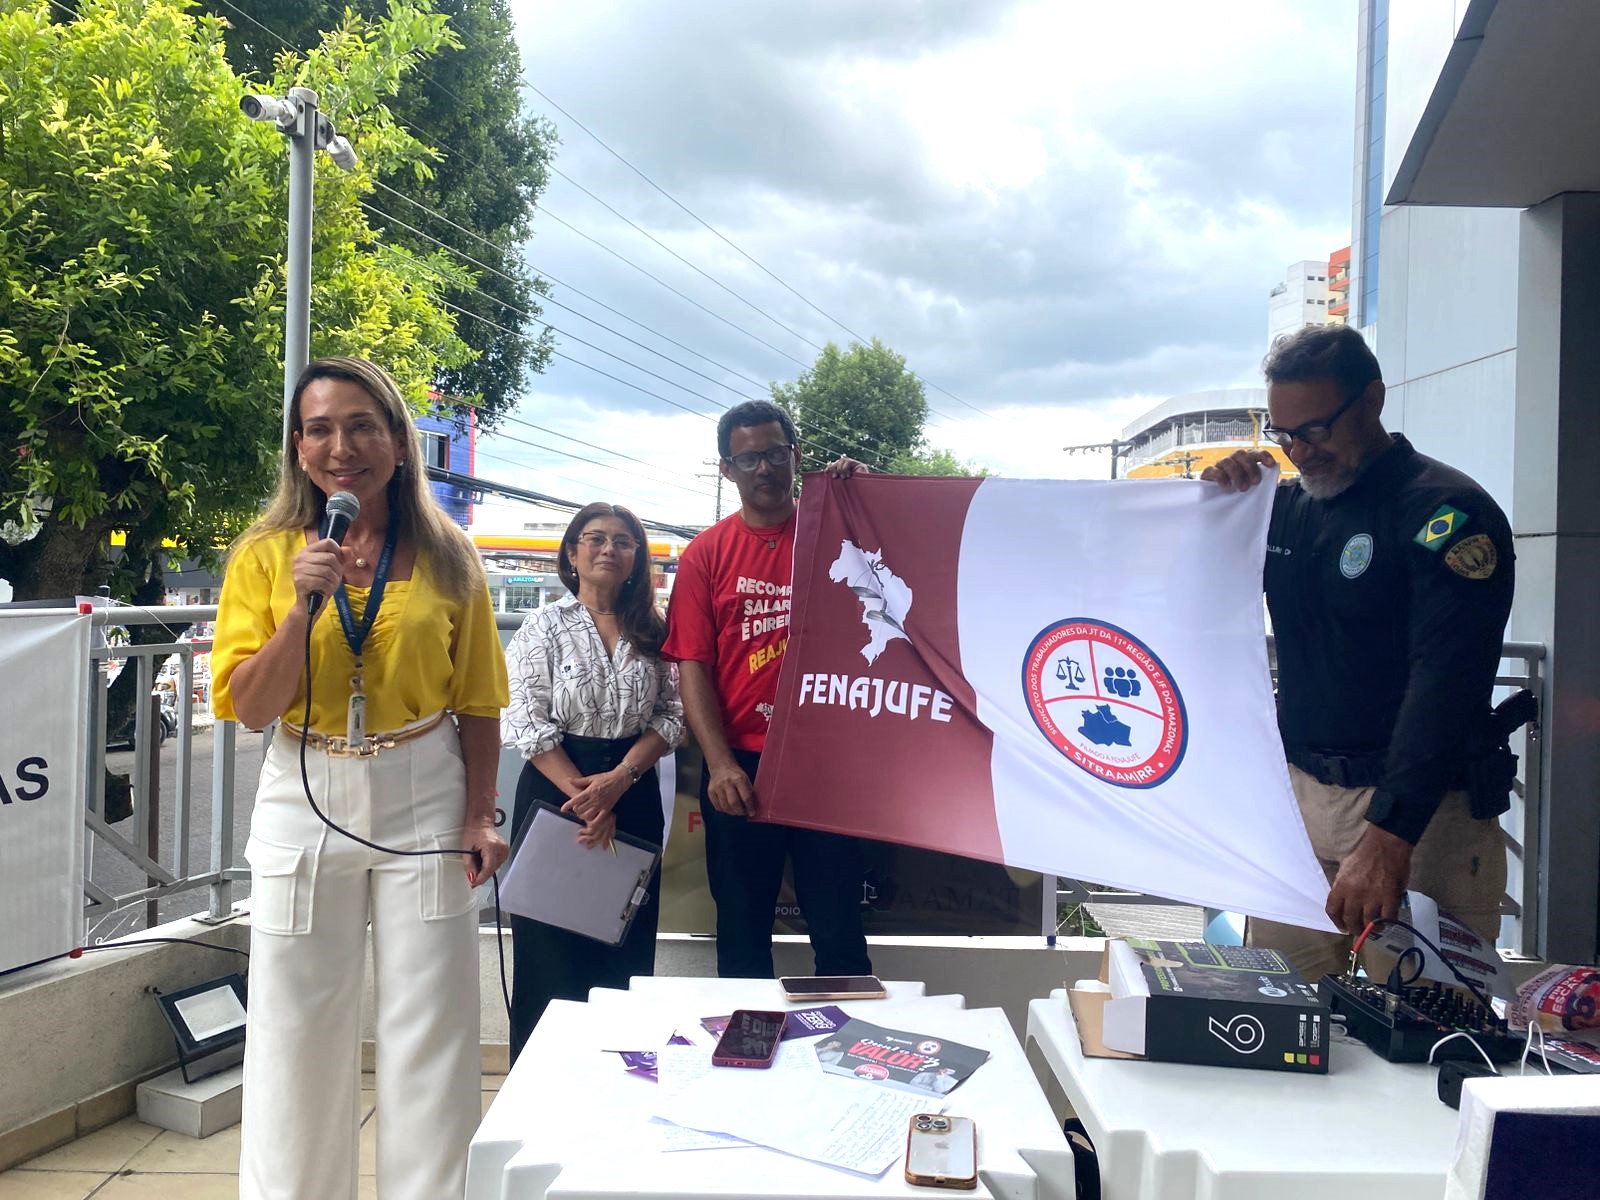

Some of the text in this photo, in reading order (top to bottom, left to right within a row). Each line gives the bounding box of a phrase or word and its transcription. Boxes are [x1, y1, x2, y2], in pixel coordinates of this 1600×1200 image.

[1076, 627, 1088, 635] DA
[1100, 630, 1112, 640] DA
[1031, 627, 1075, 672] TRABALHADORES
[1126, 643, 1155, 672] REGIÃO
[1152, 671, 1160, 679] E
[1156, 679, 1167, 689] JF
[798, 673, 954, 723] FENAJUFE
[1162, 690, 1173, 704] DO
[1032, 691, 1057, 736] SINDICATO
[1163, 706, 1177, 755] AMAZONAS
[1208, 1014, 1265, 1054] 6
